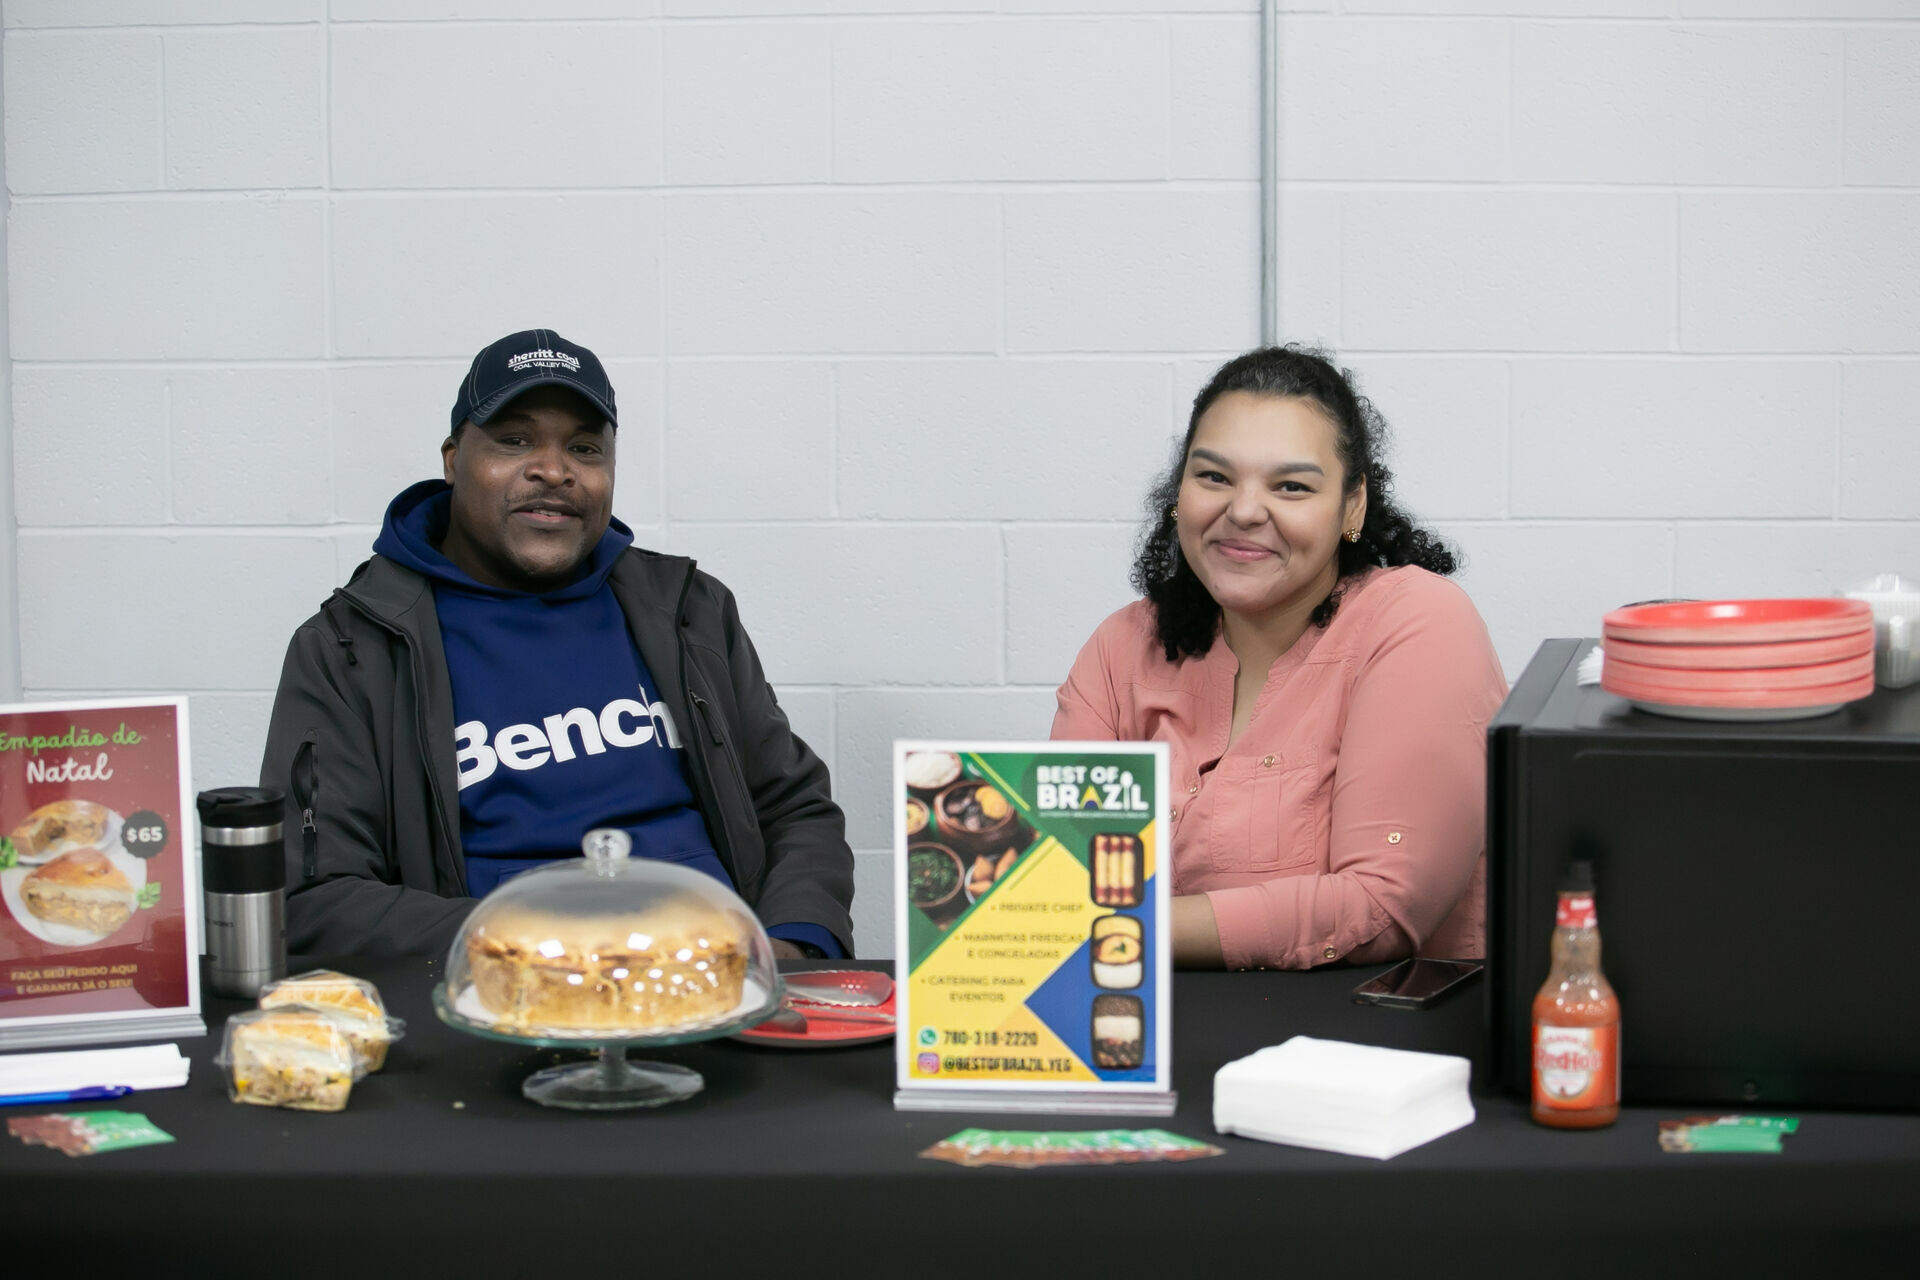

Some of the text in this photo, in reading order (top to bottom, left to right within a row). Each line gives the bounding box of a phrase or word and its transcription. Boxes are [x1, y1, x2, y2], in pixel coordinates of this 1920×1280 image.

[508, 349, 580, 366] sherritt coal
[513, 363, 533, 372] COAL
[112, 722, 142, 745] de
[454, 683, 684, 792] Bench
[26, 752, 114, 784] Natal
[1037, 765, 1119, 784] BEST OF
[1036, 771, 1150, 811] BRAZIL
[126, 826, 163, 844] $65
[1000, 902, 1084, 913] PRIVATE CHEF
[967, 949, 975, 959] E
[97, 980, 108, 989] O
